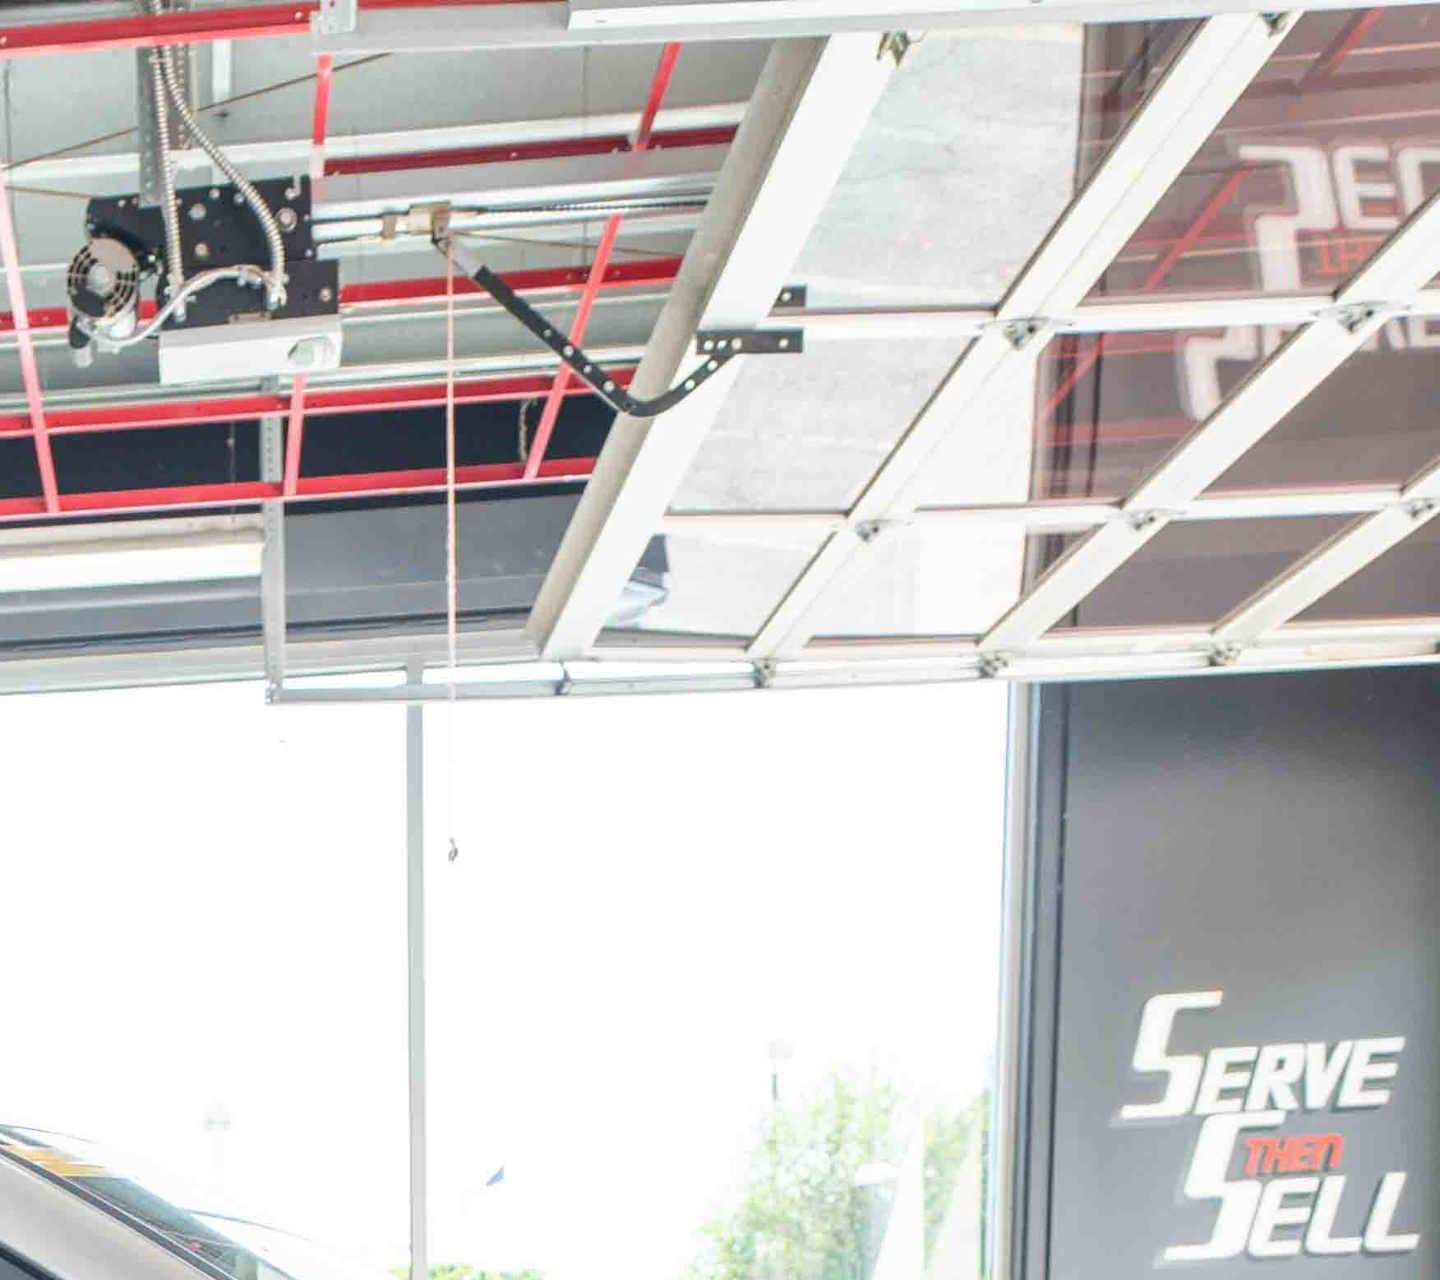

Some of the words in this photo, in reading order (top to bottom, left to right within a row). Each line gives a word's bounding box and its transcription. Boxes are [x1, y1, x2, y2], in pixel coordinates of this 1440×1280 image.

[1121, 990, 1406, 1119] SERVE
[1163, 1110, 1419, 1262] SELL
[1243, 1132, 1344, 1177] THEN
